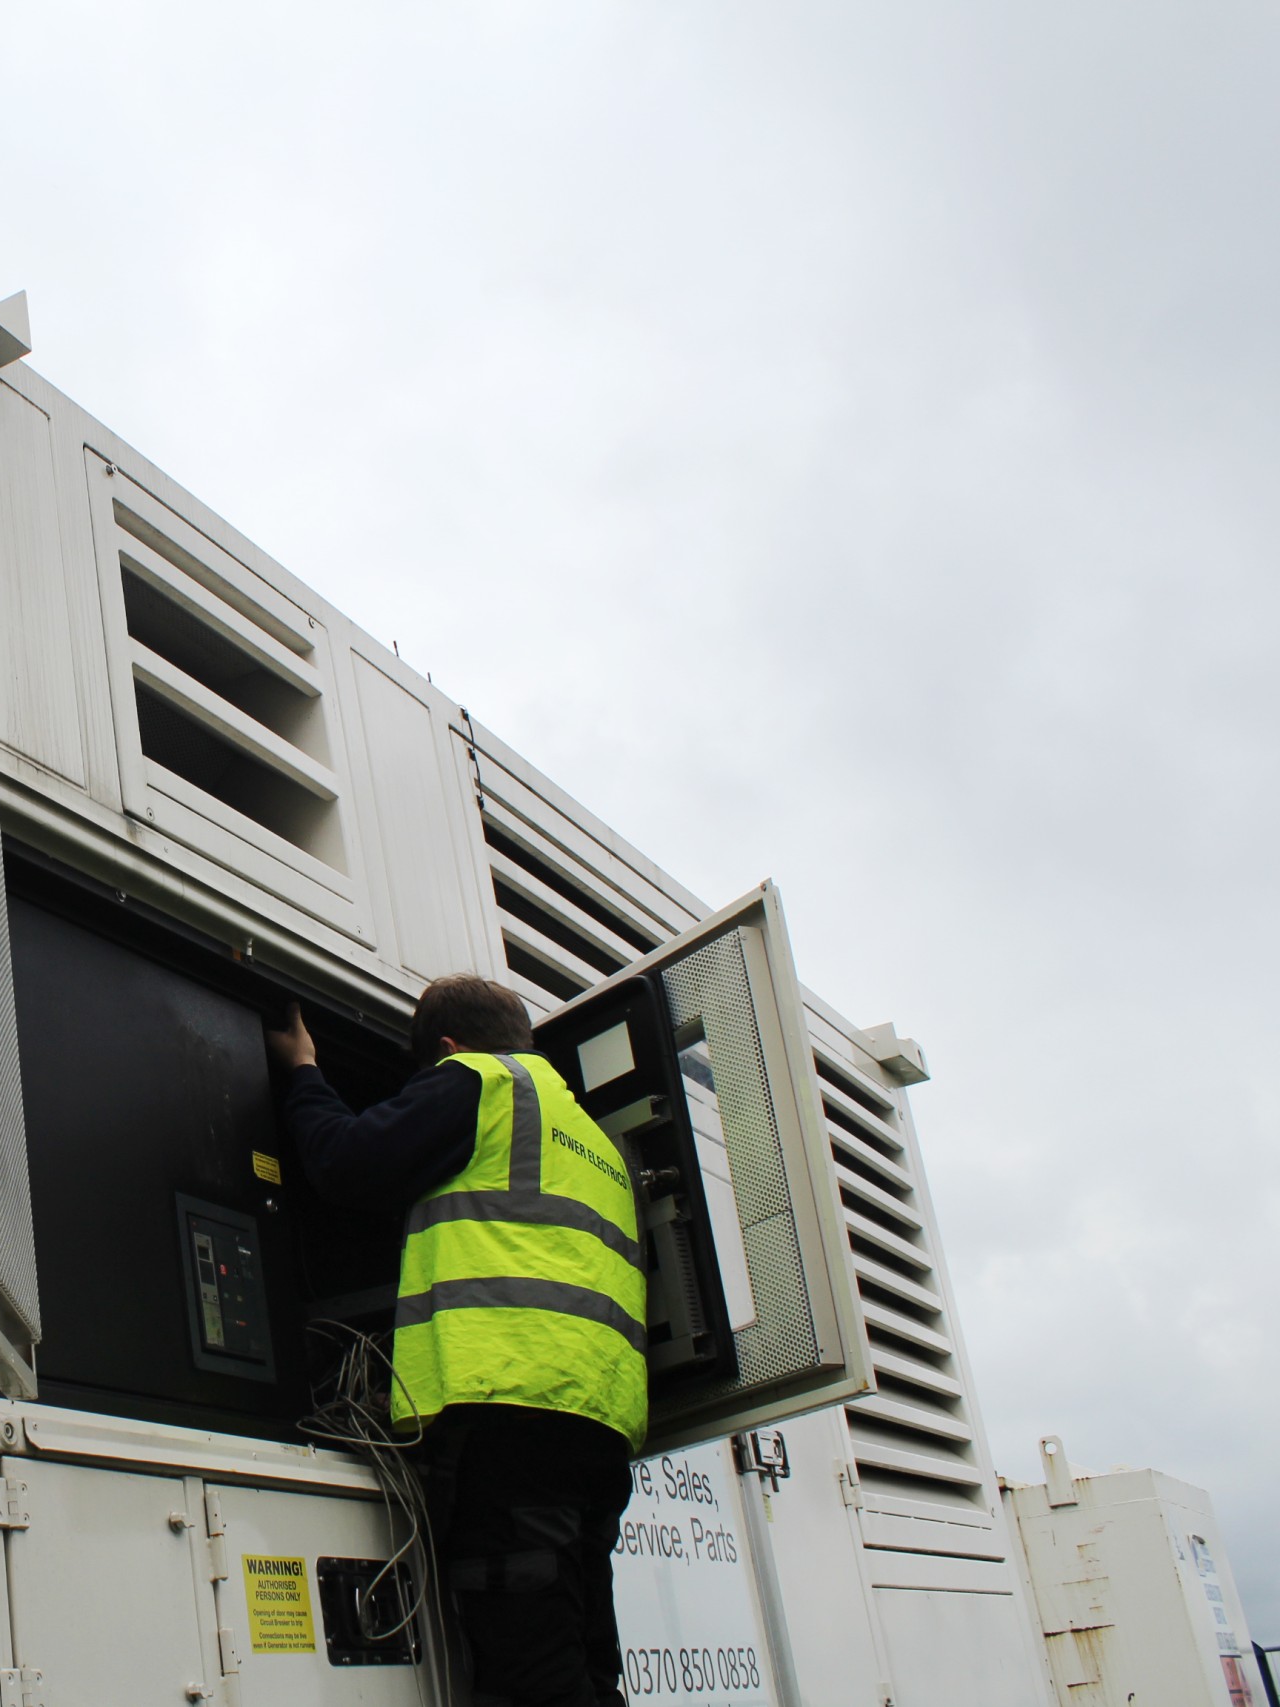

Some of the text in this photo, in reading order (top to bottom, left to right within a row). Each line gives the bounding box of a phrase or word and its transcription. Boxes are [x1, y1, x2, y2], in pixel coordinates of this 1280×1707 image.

[552, 1127, 628, 1190] POWER ELECTRICS
[661, 1455, 719, 1512] Sales,
[690, 1517, 738, 1564] Parts
[246, 1558, 303, 1577] WARNING!
[255, 1591, 301, 1602] PERSONS ONLY
[257, 1580, 297, 1590] AUTHORISED
[253, 1609, 271, 1618] Opening
[626, 1646, 761, 1695] 0370 850 0858
